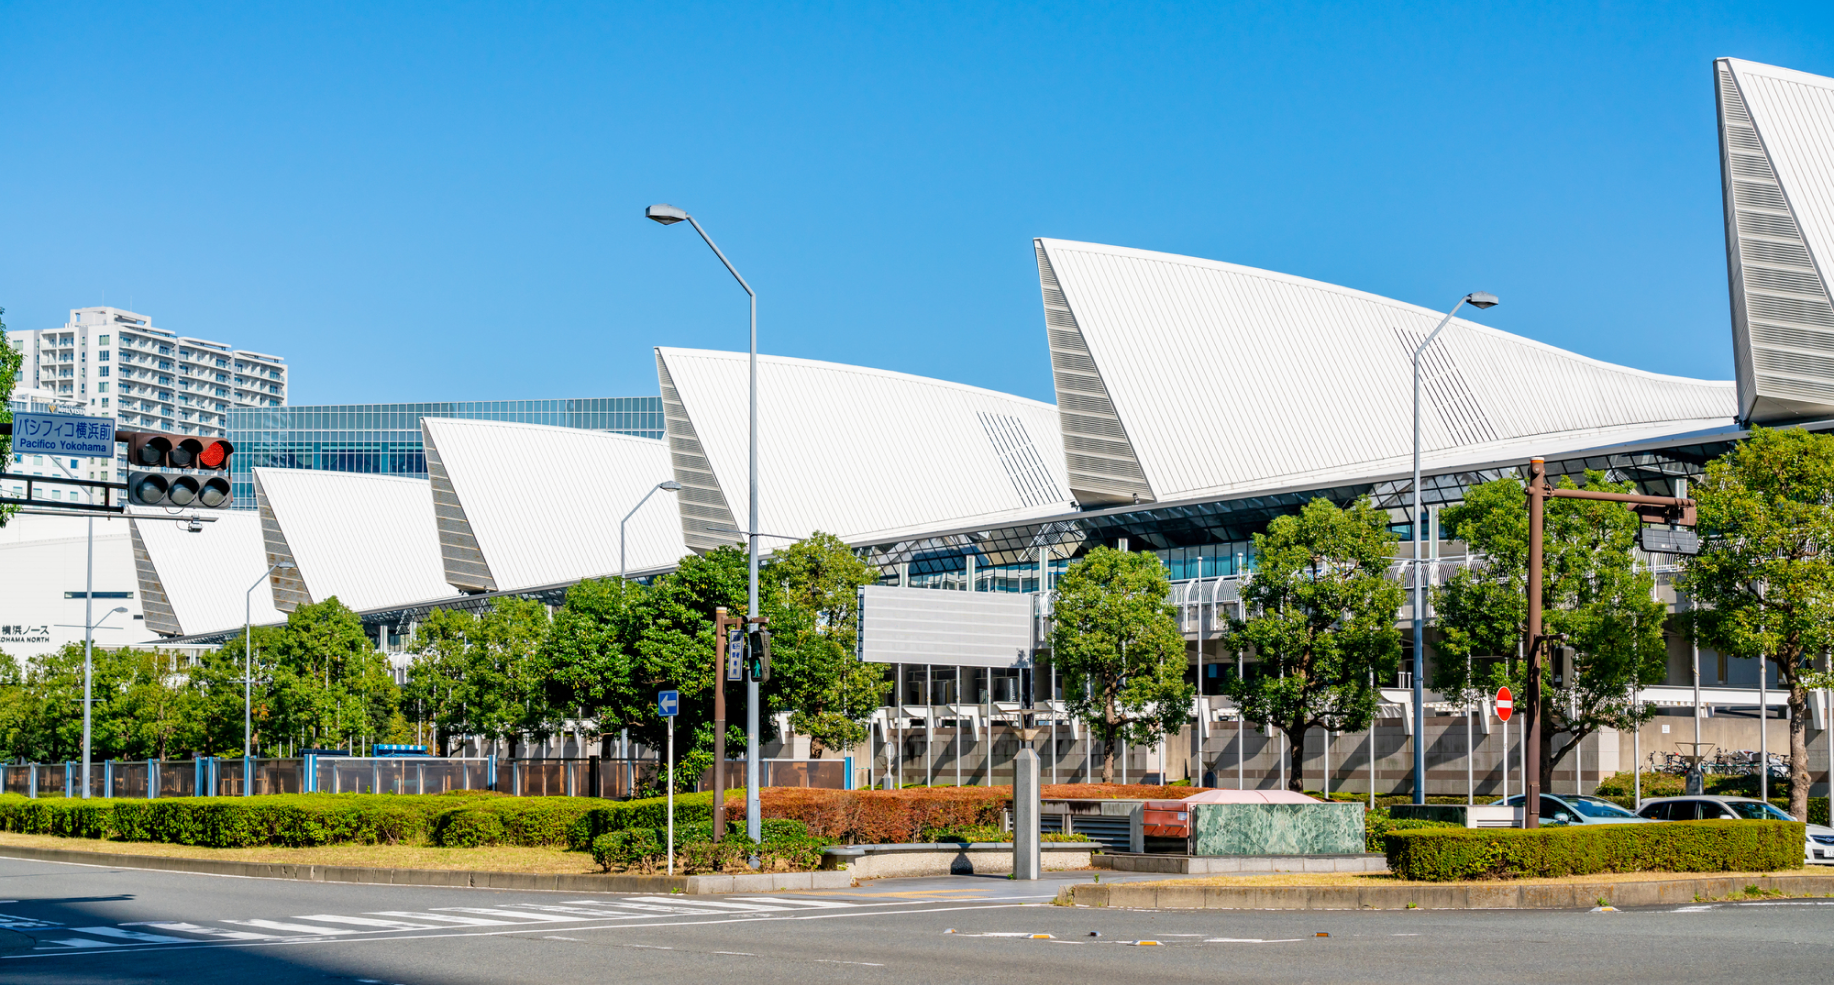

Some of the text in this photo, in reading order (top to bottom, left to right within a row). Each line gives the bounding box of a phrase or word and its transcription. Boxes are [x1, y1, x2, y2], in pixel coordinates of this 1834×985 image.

[17, 418, 111, 440] パシフィコ横浜前
[20, 438, 106, 452] Pacifico Yokohama
